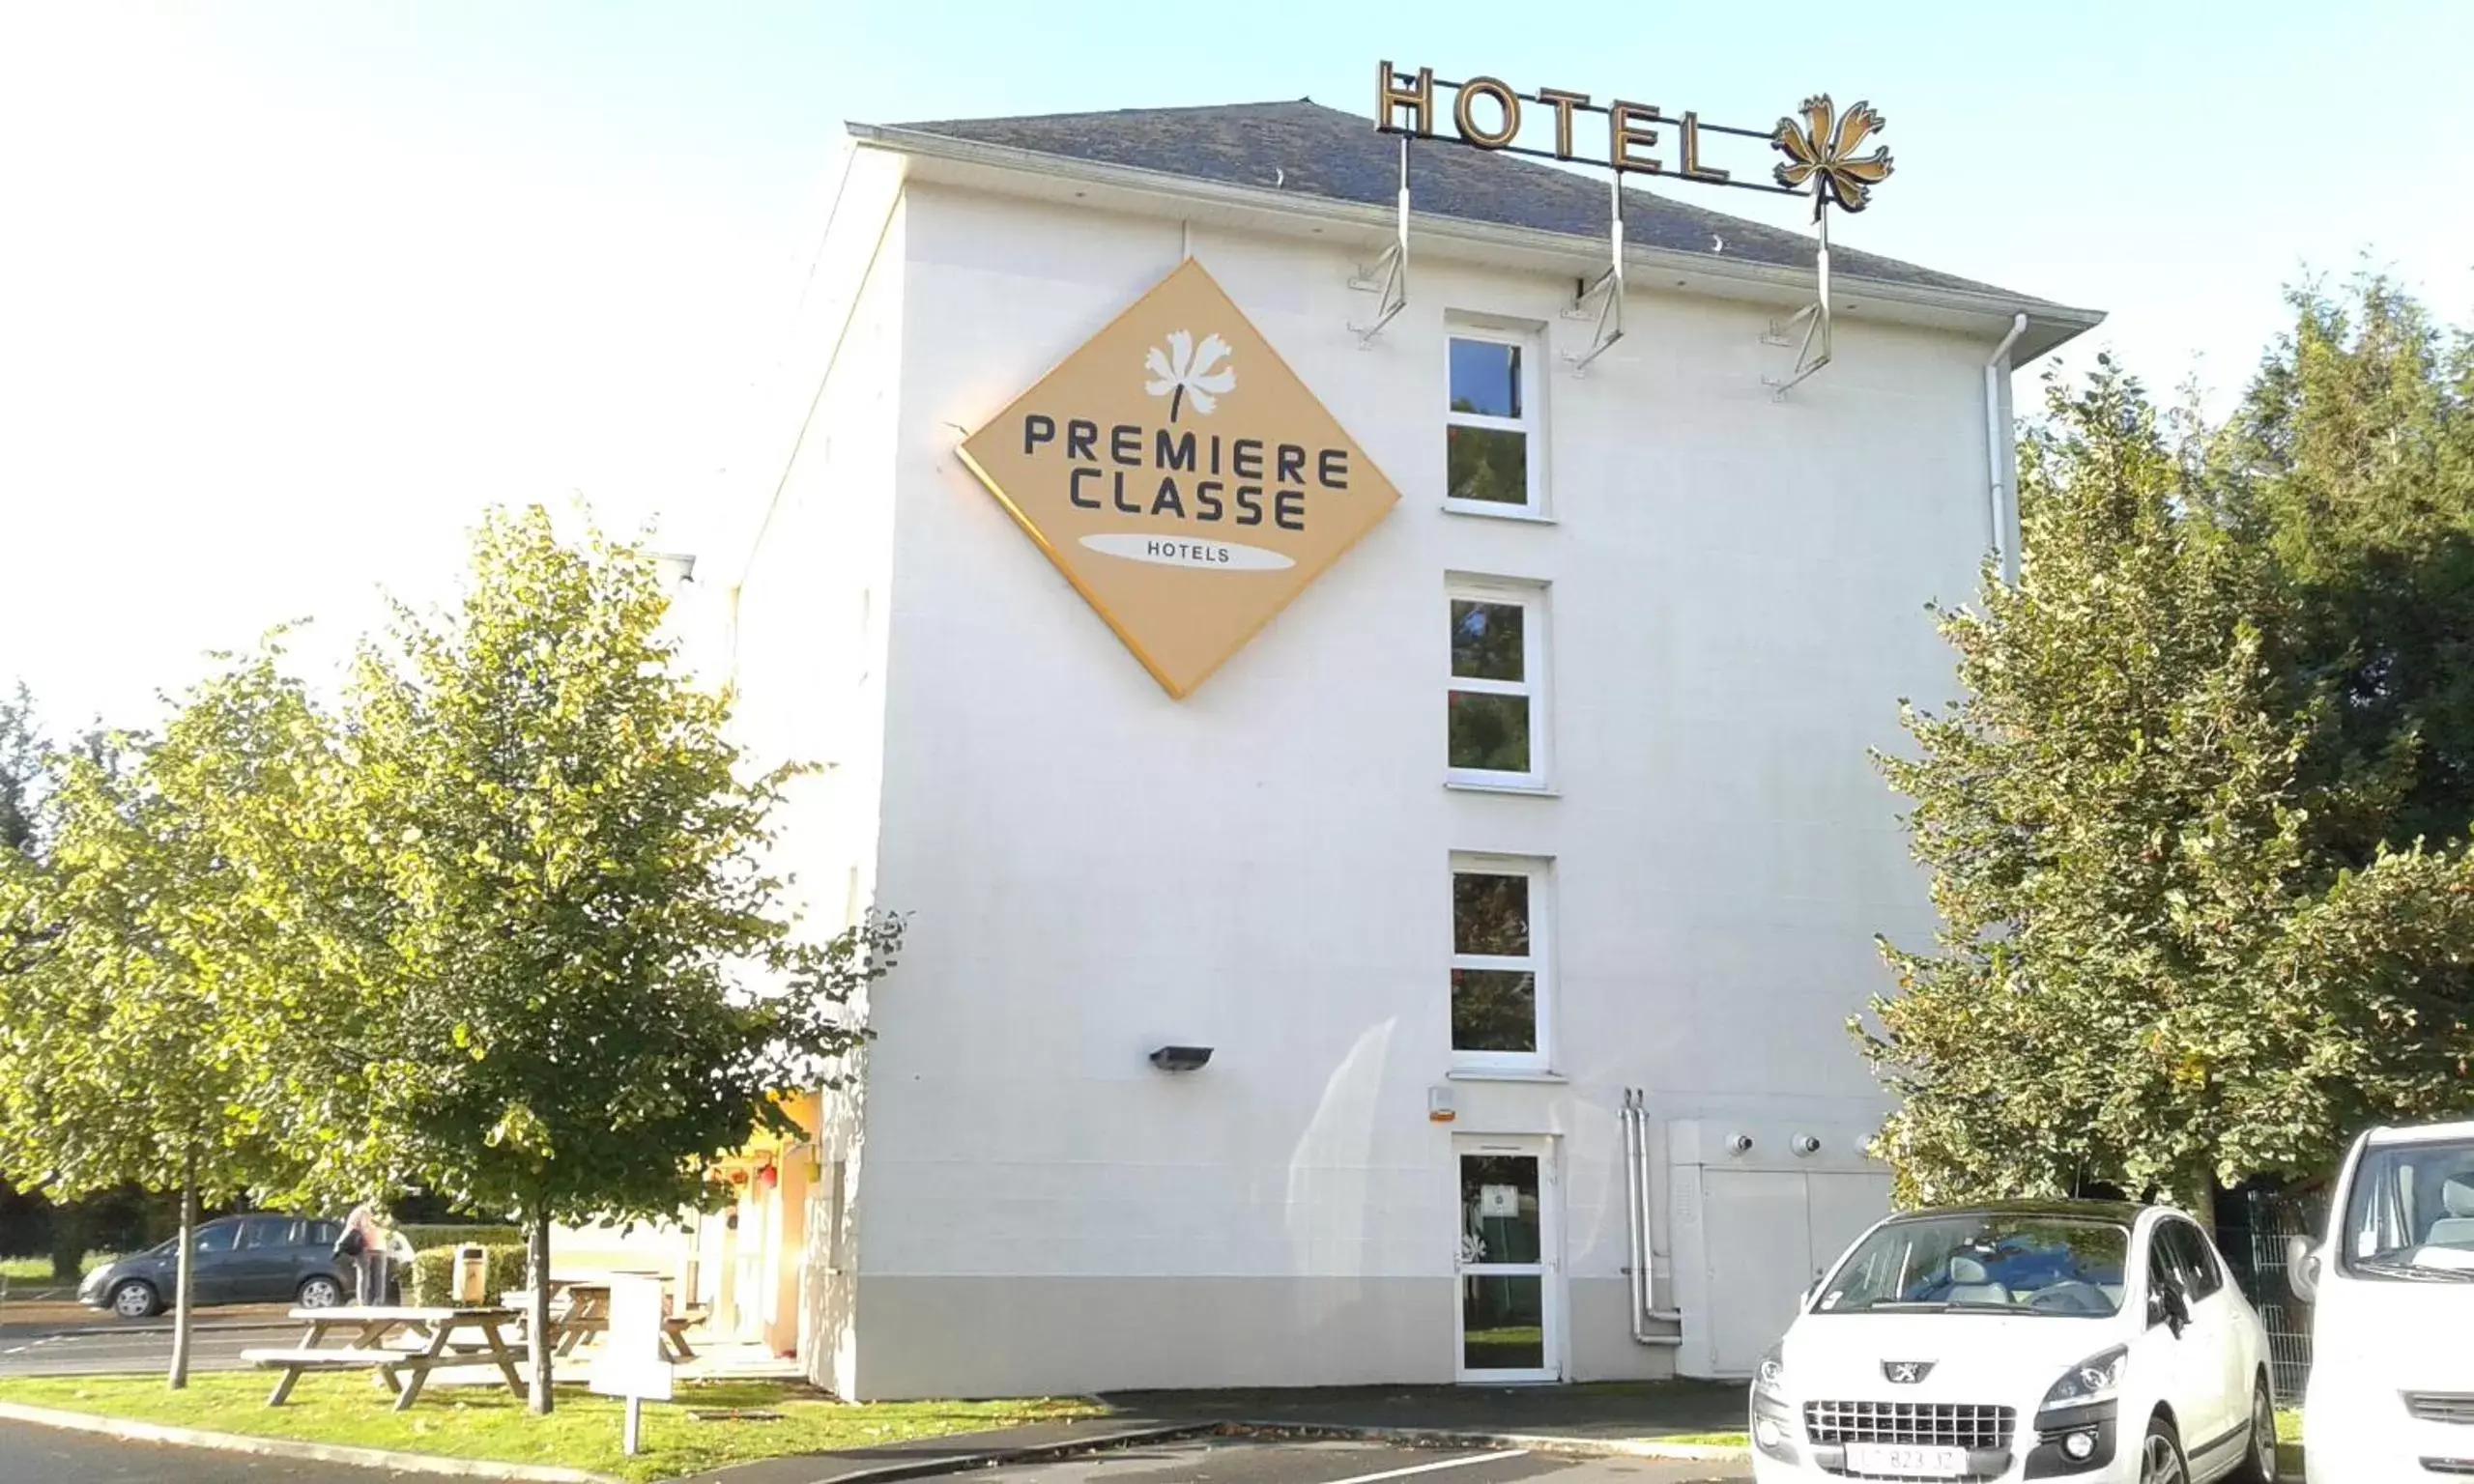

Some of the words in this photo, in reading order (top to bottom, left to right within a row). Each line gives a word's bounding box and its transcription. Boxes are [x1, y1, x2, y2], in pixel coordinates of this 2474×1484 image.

[1376, 59, 1730, 186] HOTEL
[1024, 414, 1348, 489] PREMIERE
[1070, 468, 1306, 530] CLASSE
[1147, 540, 1229, 563] HOTELS
